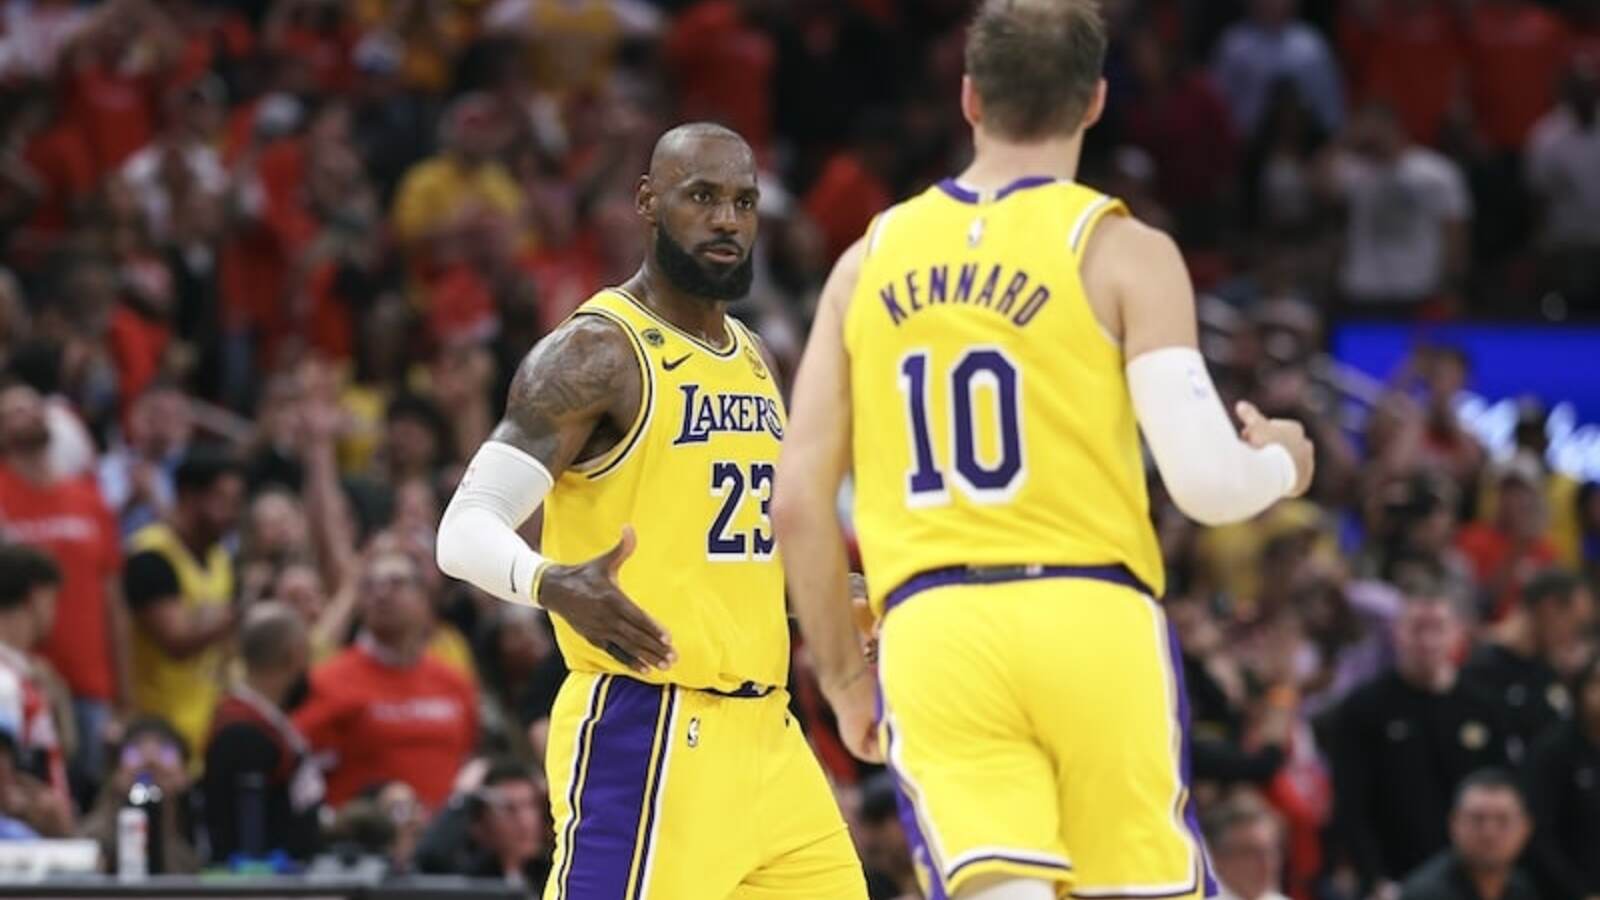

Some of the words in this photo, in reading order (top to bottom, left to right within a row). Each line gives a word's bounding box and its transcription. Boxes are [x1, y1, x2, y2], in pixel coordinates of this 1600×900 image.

[879, 263, 1050, 327] KENNARD
[672, 383, 784, 442] LAKERS
[900, 348, 1023, 498] 10
[707, 461, 776, 557] 23
